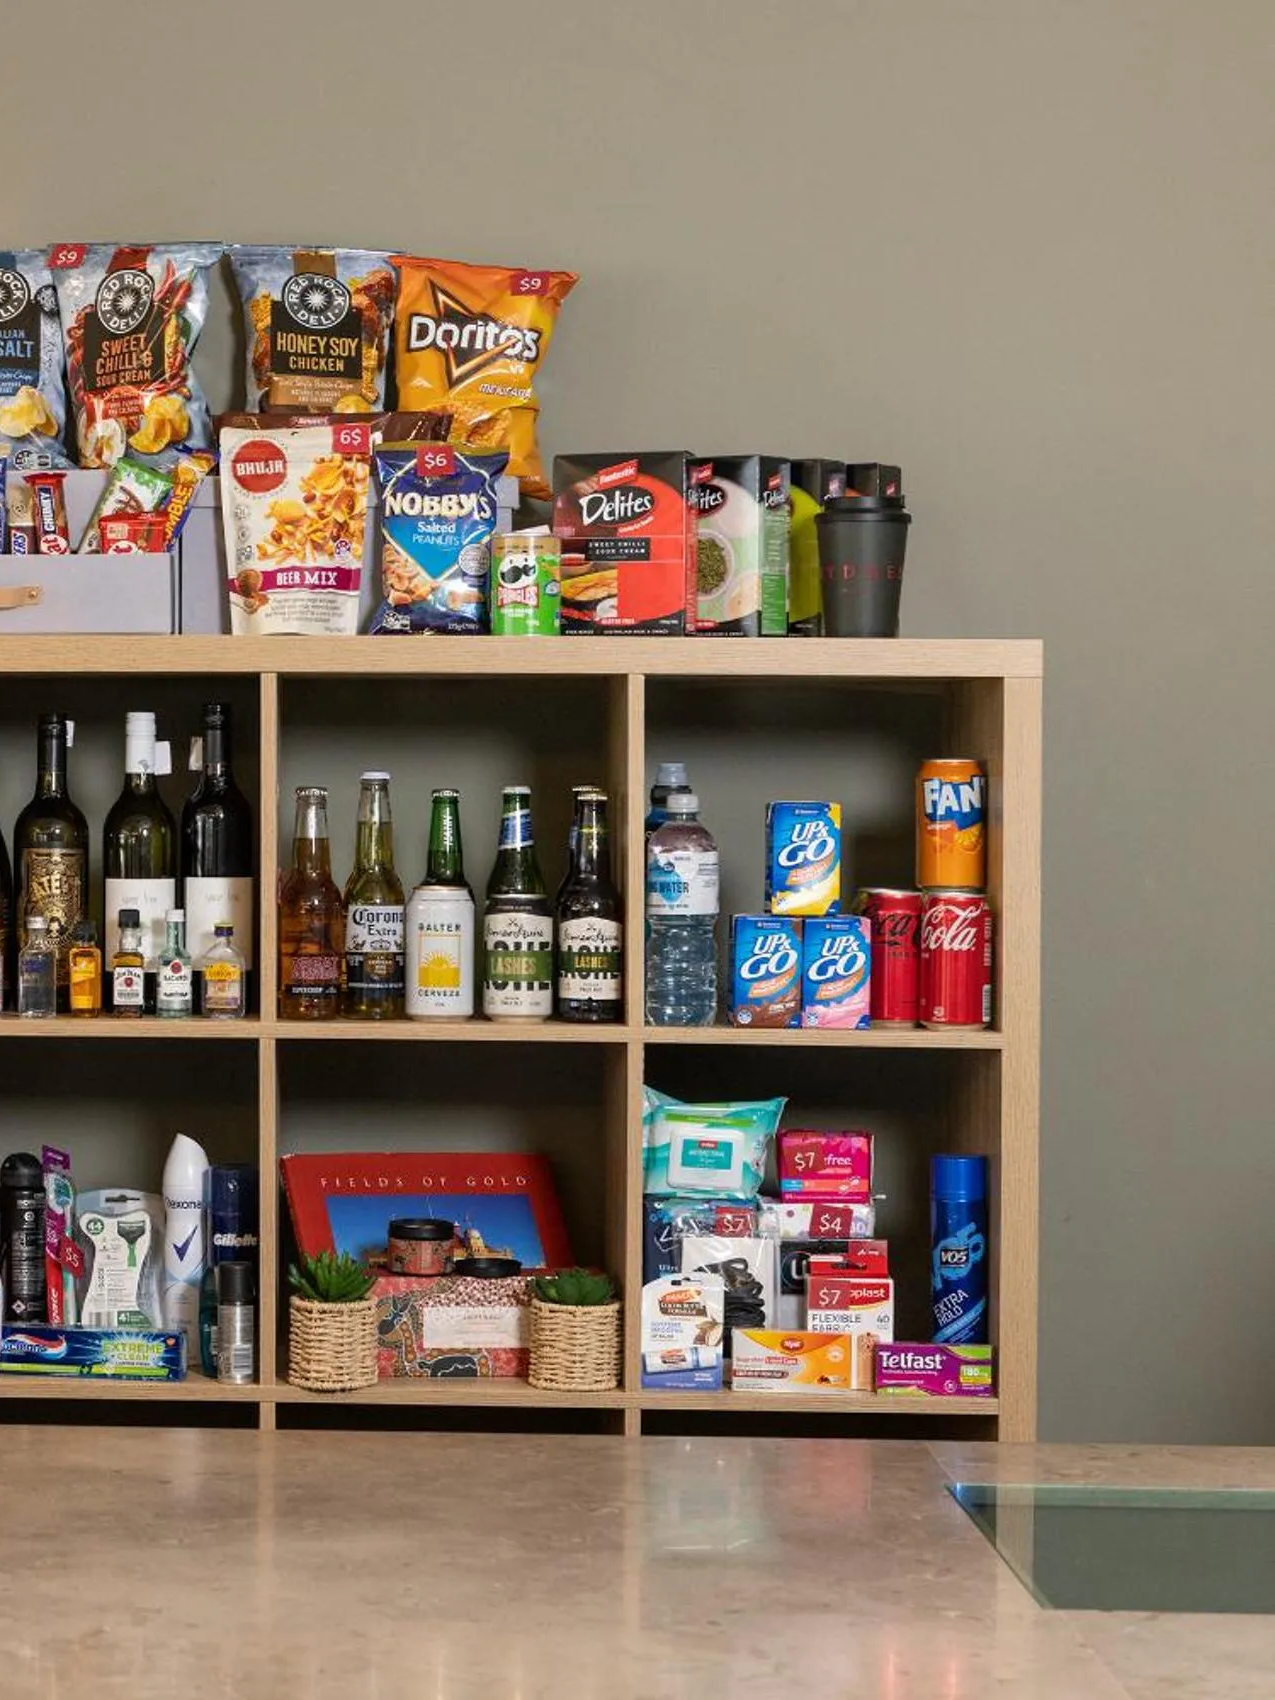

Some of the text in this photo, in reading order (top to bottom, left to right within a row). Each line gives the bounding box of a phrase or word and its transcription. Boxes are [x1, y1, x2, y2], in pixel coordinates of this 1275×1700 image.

[57, 251, 77, 264] $9
[289, 277, 345, 306] RED ROCK
[520, 277, 542, 291] $9
[102, 280, 120, 311] RED
[110, 311, 140, 329] DELI
[297, 310, 336, 325] DELI
[102, 334, 147, 357] SWEET
[277, 332, 359, 357] HONEY SOY
[410, 314, 539, 359] Doritos
[96, 352, 137, 374] CHILLI
[289, 356, 344, 372] CHICKEN
[96, 369, 151, 387] SOUR CREAM
[236, 459, 285, 476] BHUJA
[425, 453, 447, 469] $6
[39, 492, 54, 531] CHUNKY
[579, 490, 653, 526] Delites
[417, 522, 456, 534] Salted
[412, 534, 460, 546] PEANUTS
[277, 569, 338, 586] BEER MIX
[923, 775, 985, 815] FAN
[778, 837, 836, 867] GO
[368, 925, 397, 936] Extra
[740, 949, 798, 980] GO
[808, 951, 866, 981] GO
[794, 1152, 815, 1172] $7
[824, 1154, 852, 1165] free
[320, 1177, 407, 1189] FIELDS
[466, 1176, 527, 1187] GOLD
[819, 1213, 842, 1233] $4
[819, 1287, 841, 1306] $7
[933, 1289, 969, 1316] EXTRA
[812, 1314, 861, 1323] FLEXIBLE
[877, 1315, 890, 1323] 40
[936, 1305, 963, 1327] HOLD
[103, 1341, 165, 1353] EXTREME
[879, 1351, 942, 1369] Telfast
